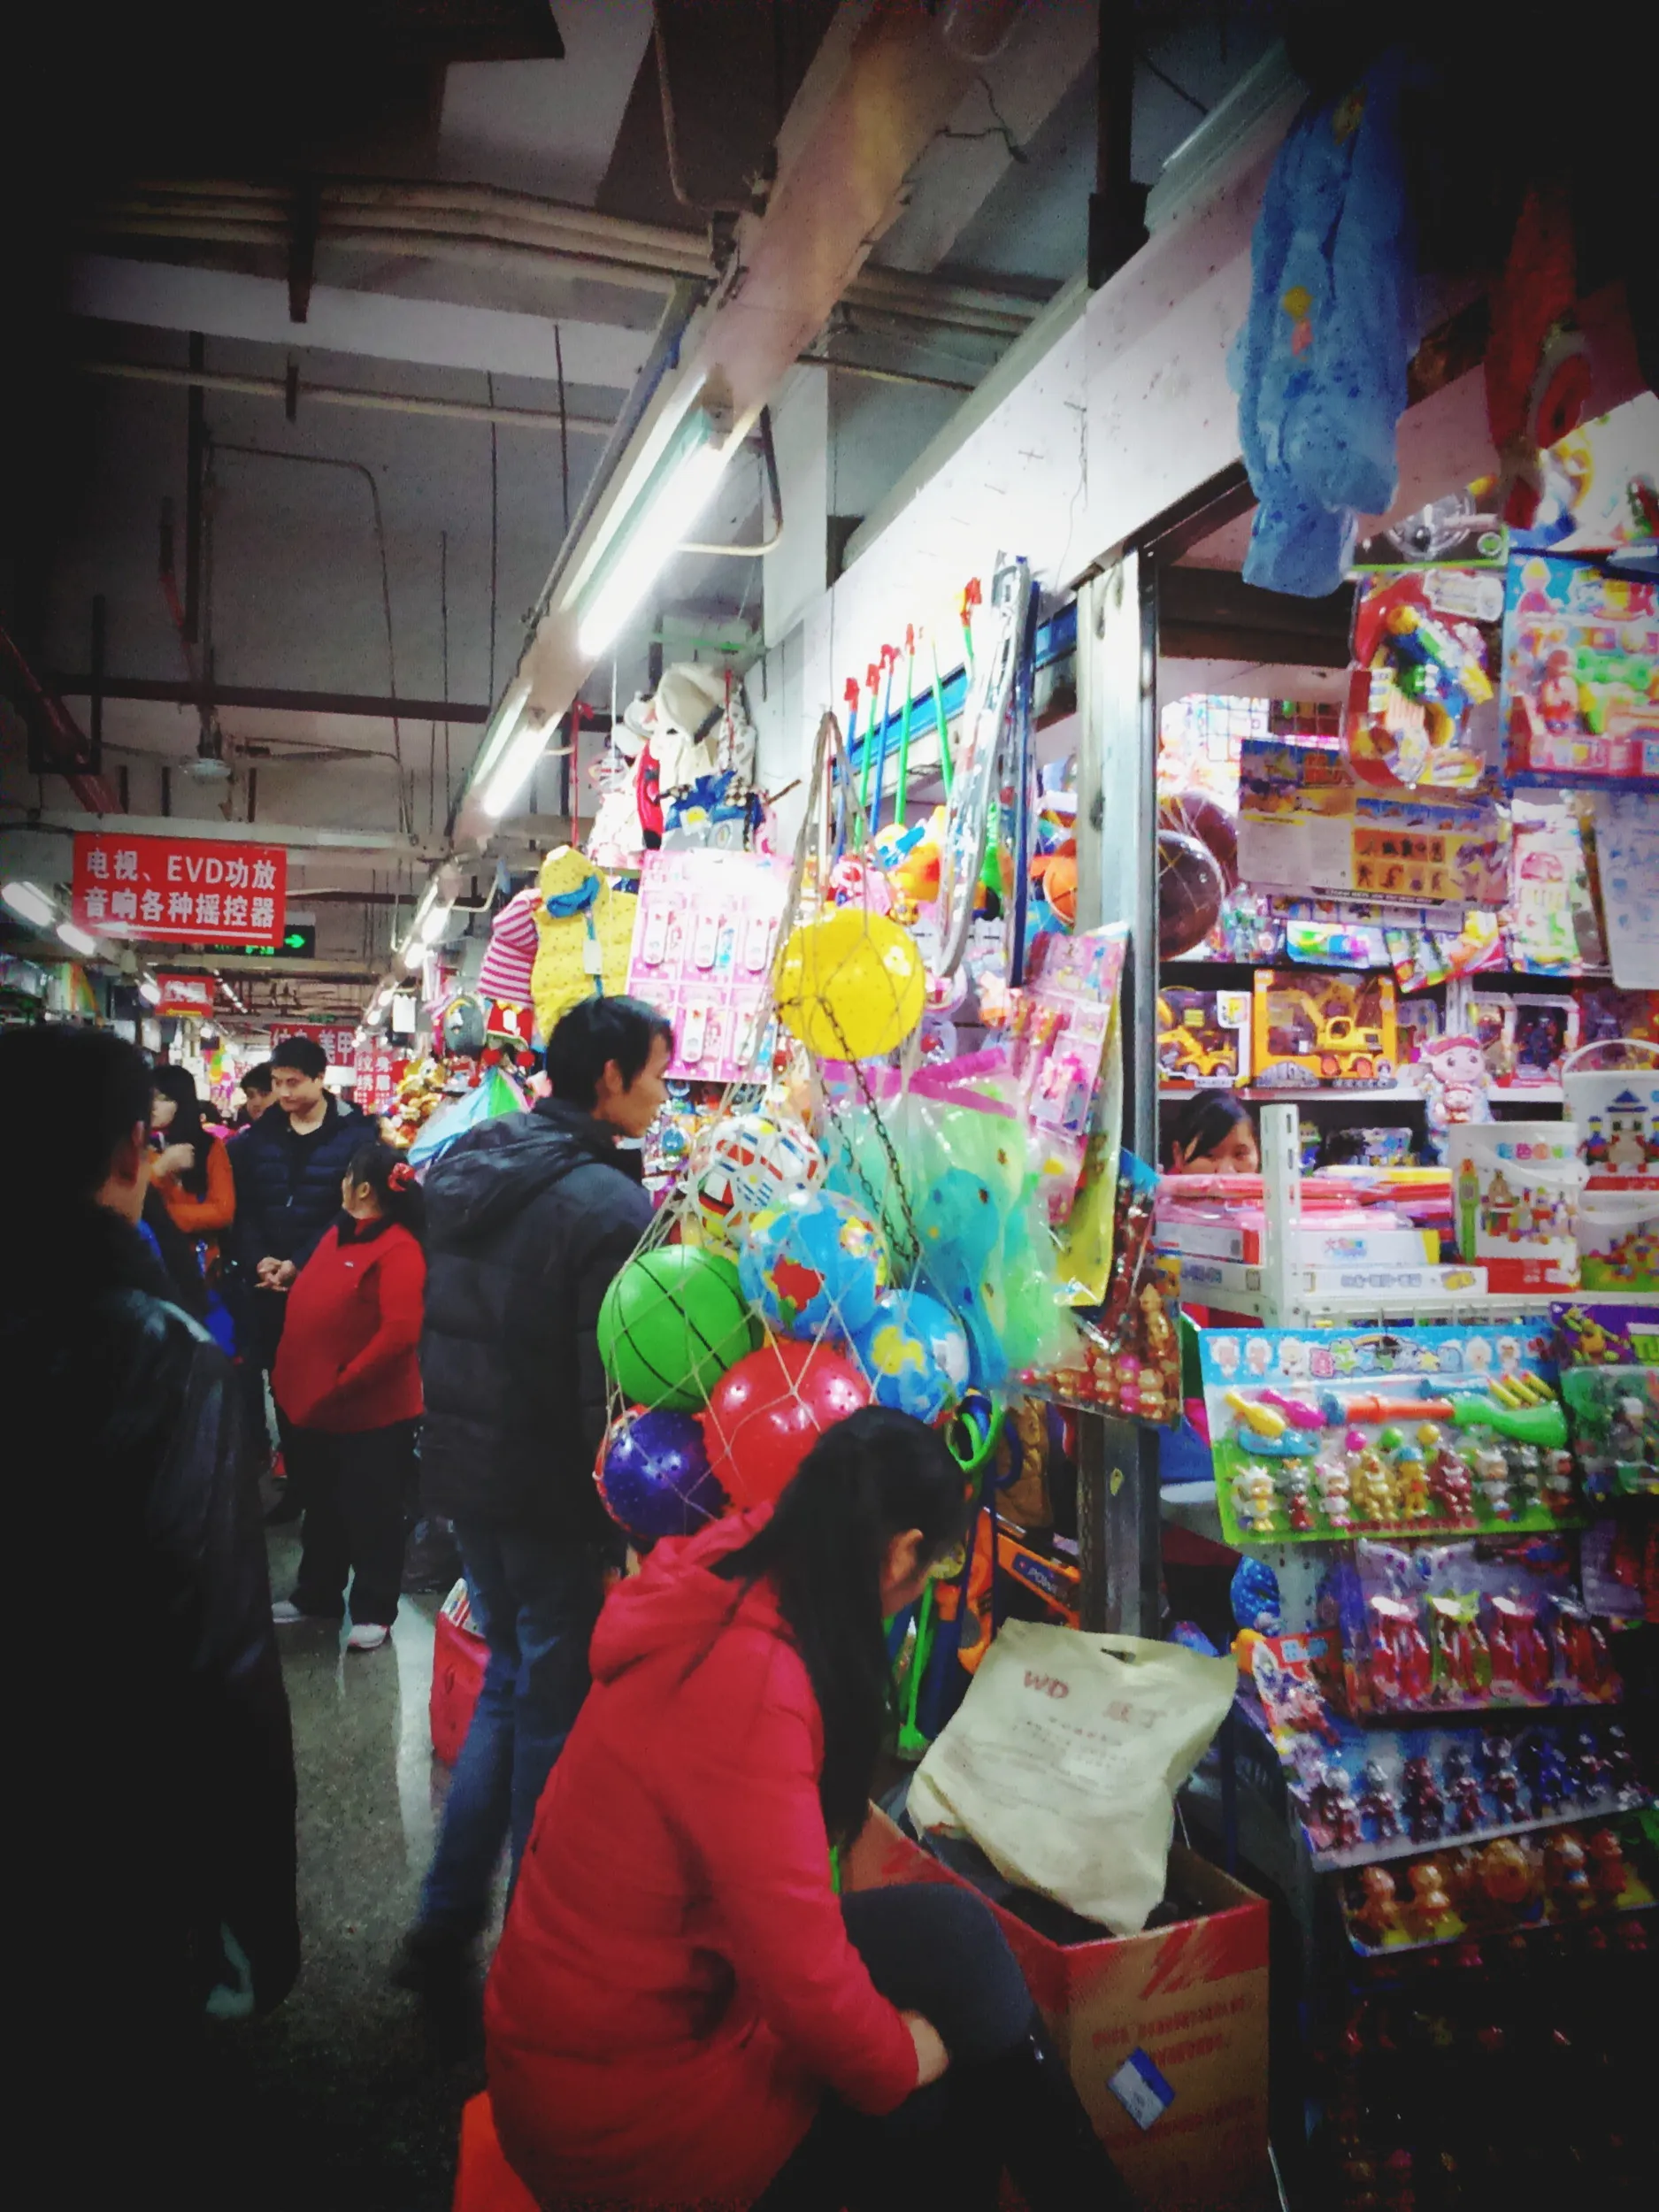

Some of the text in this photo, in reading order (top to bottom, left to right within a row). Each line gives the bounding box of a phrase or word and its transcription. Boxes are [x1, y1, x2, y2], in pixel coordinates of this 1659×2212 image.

[84, 886, 275, 927] 音响各种摇控器
